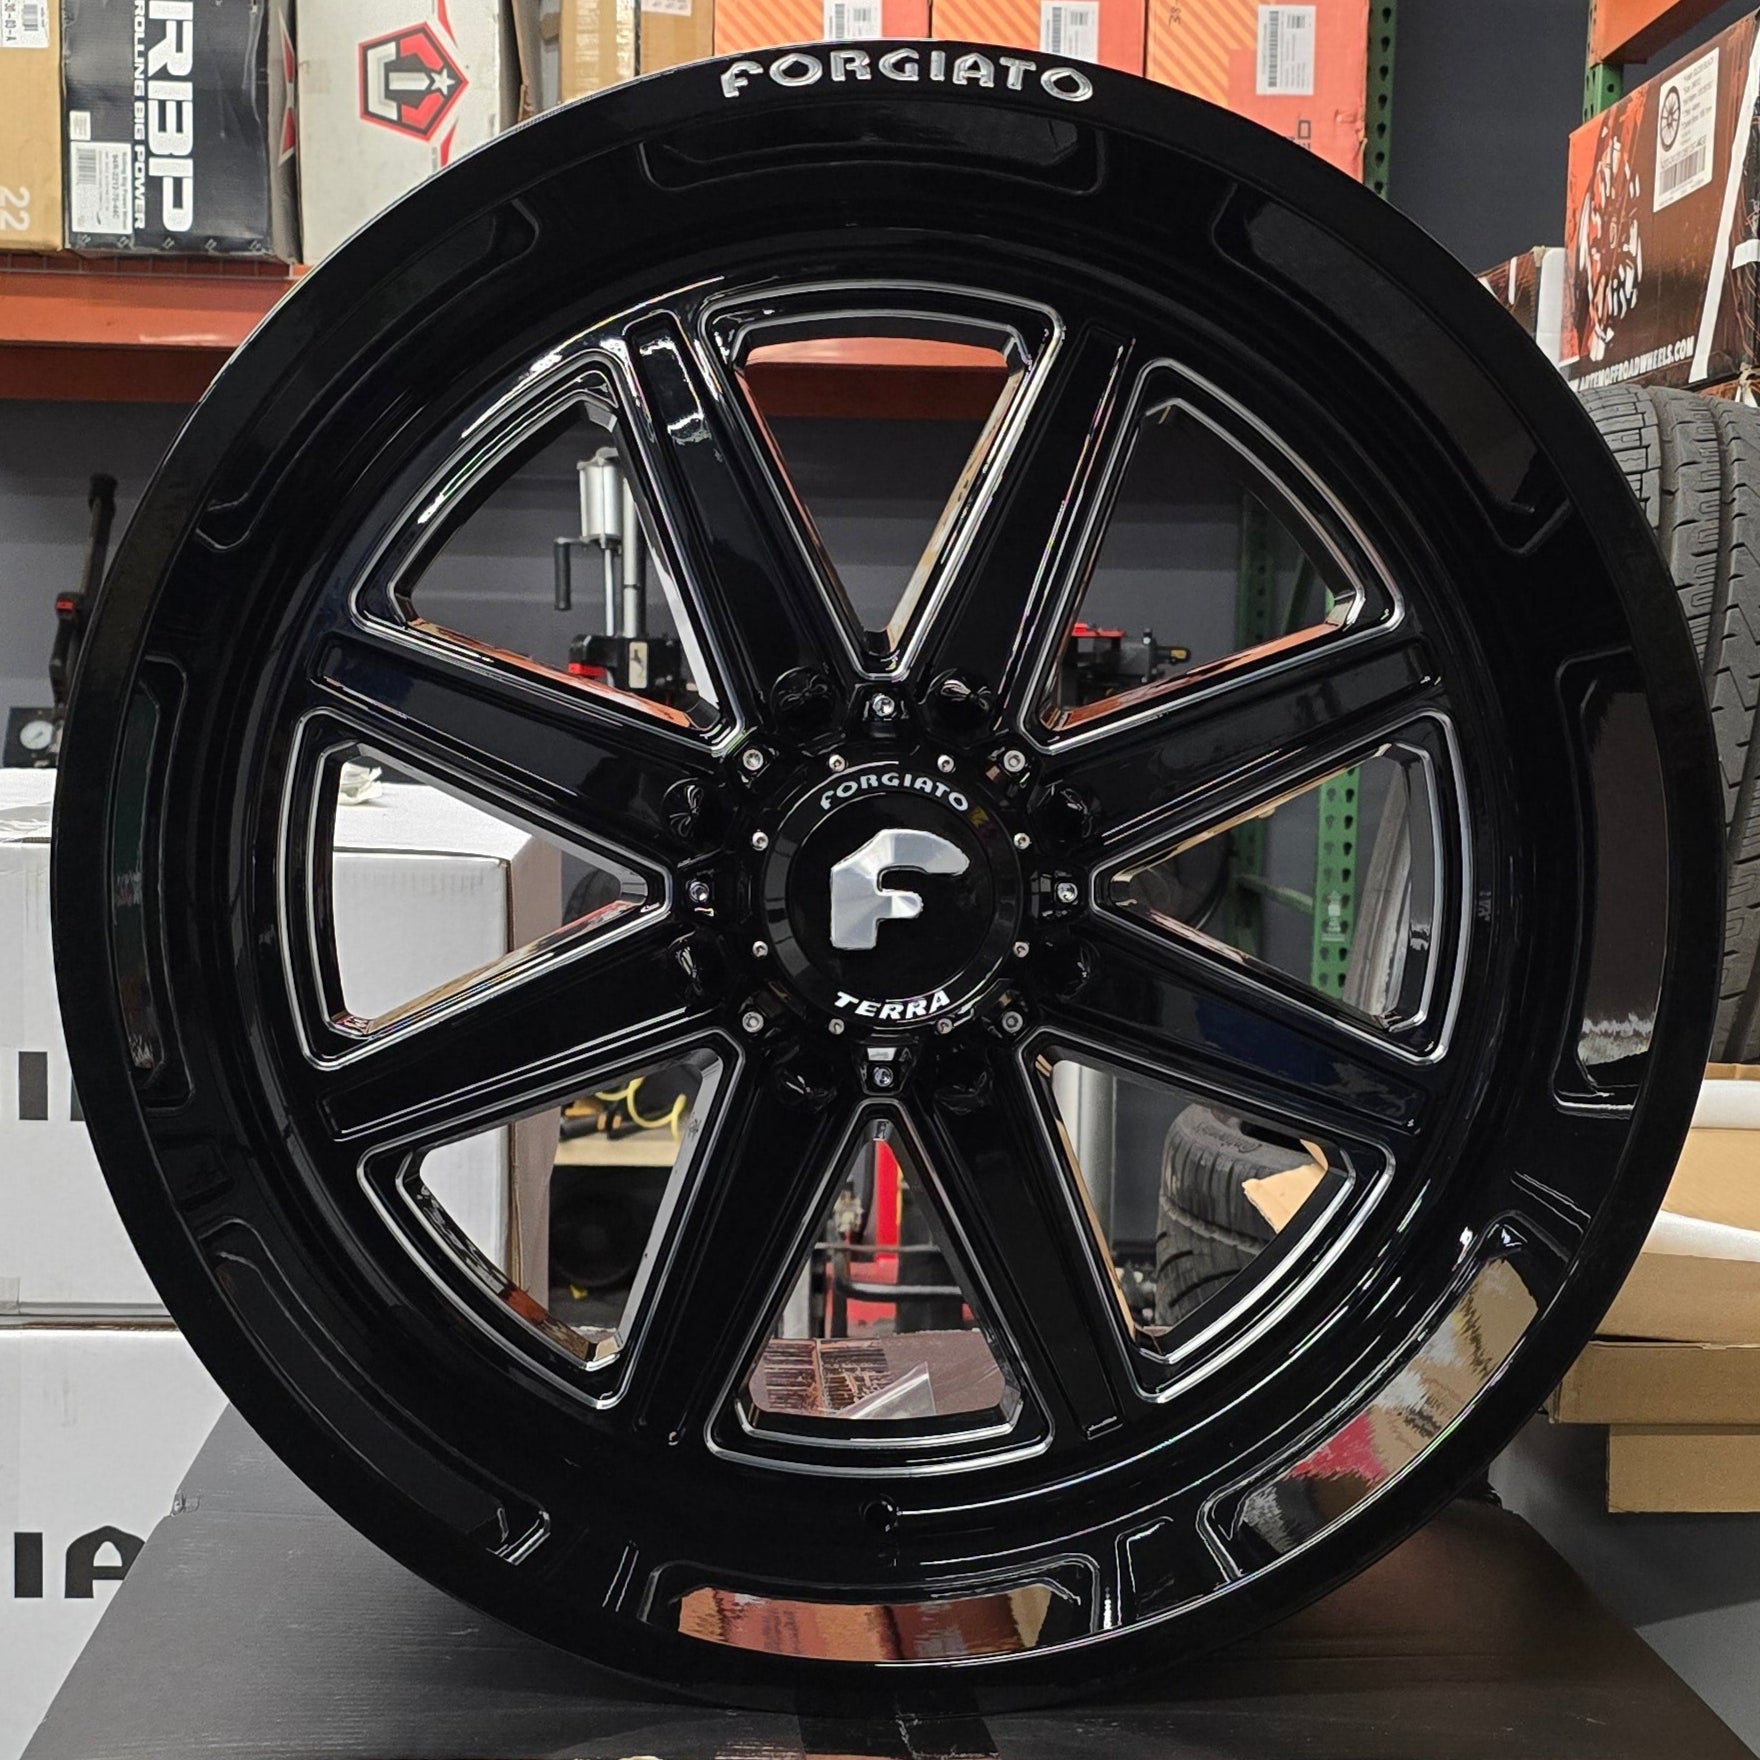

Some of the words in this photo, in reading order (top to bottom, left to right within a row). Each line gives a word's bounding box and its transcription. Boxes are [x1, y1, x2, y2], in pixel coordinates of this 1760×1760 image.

[134, 0, 145, 96] ROLLING
[719, 47, 1094, 102] FORGIATO
[134, 101, 145, 140] BIG
[148, 0, 193, 231] RBP
[0, 186, 30, 232] 22
[134, 144, 145, 229] POWER
[820, 772, 968, 811] FORGIATO
[834, 989, 950, 1020] TERRA
